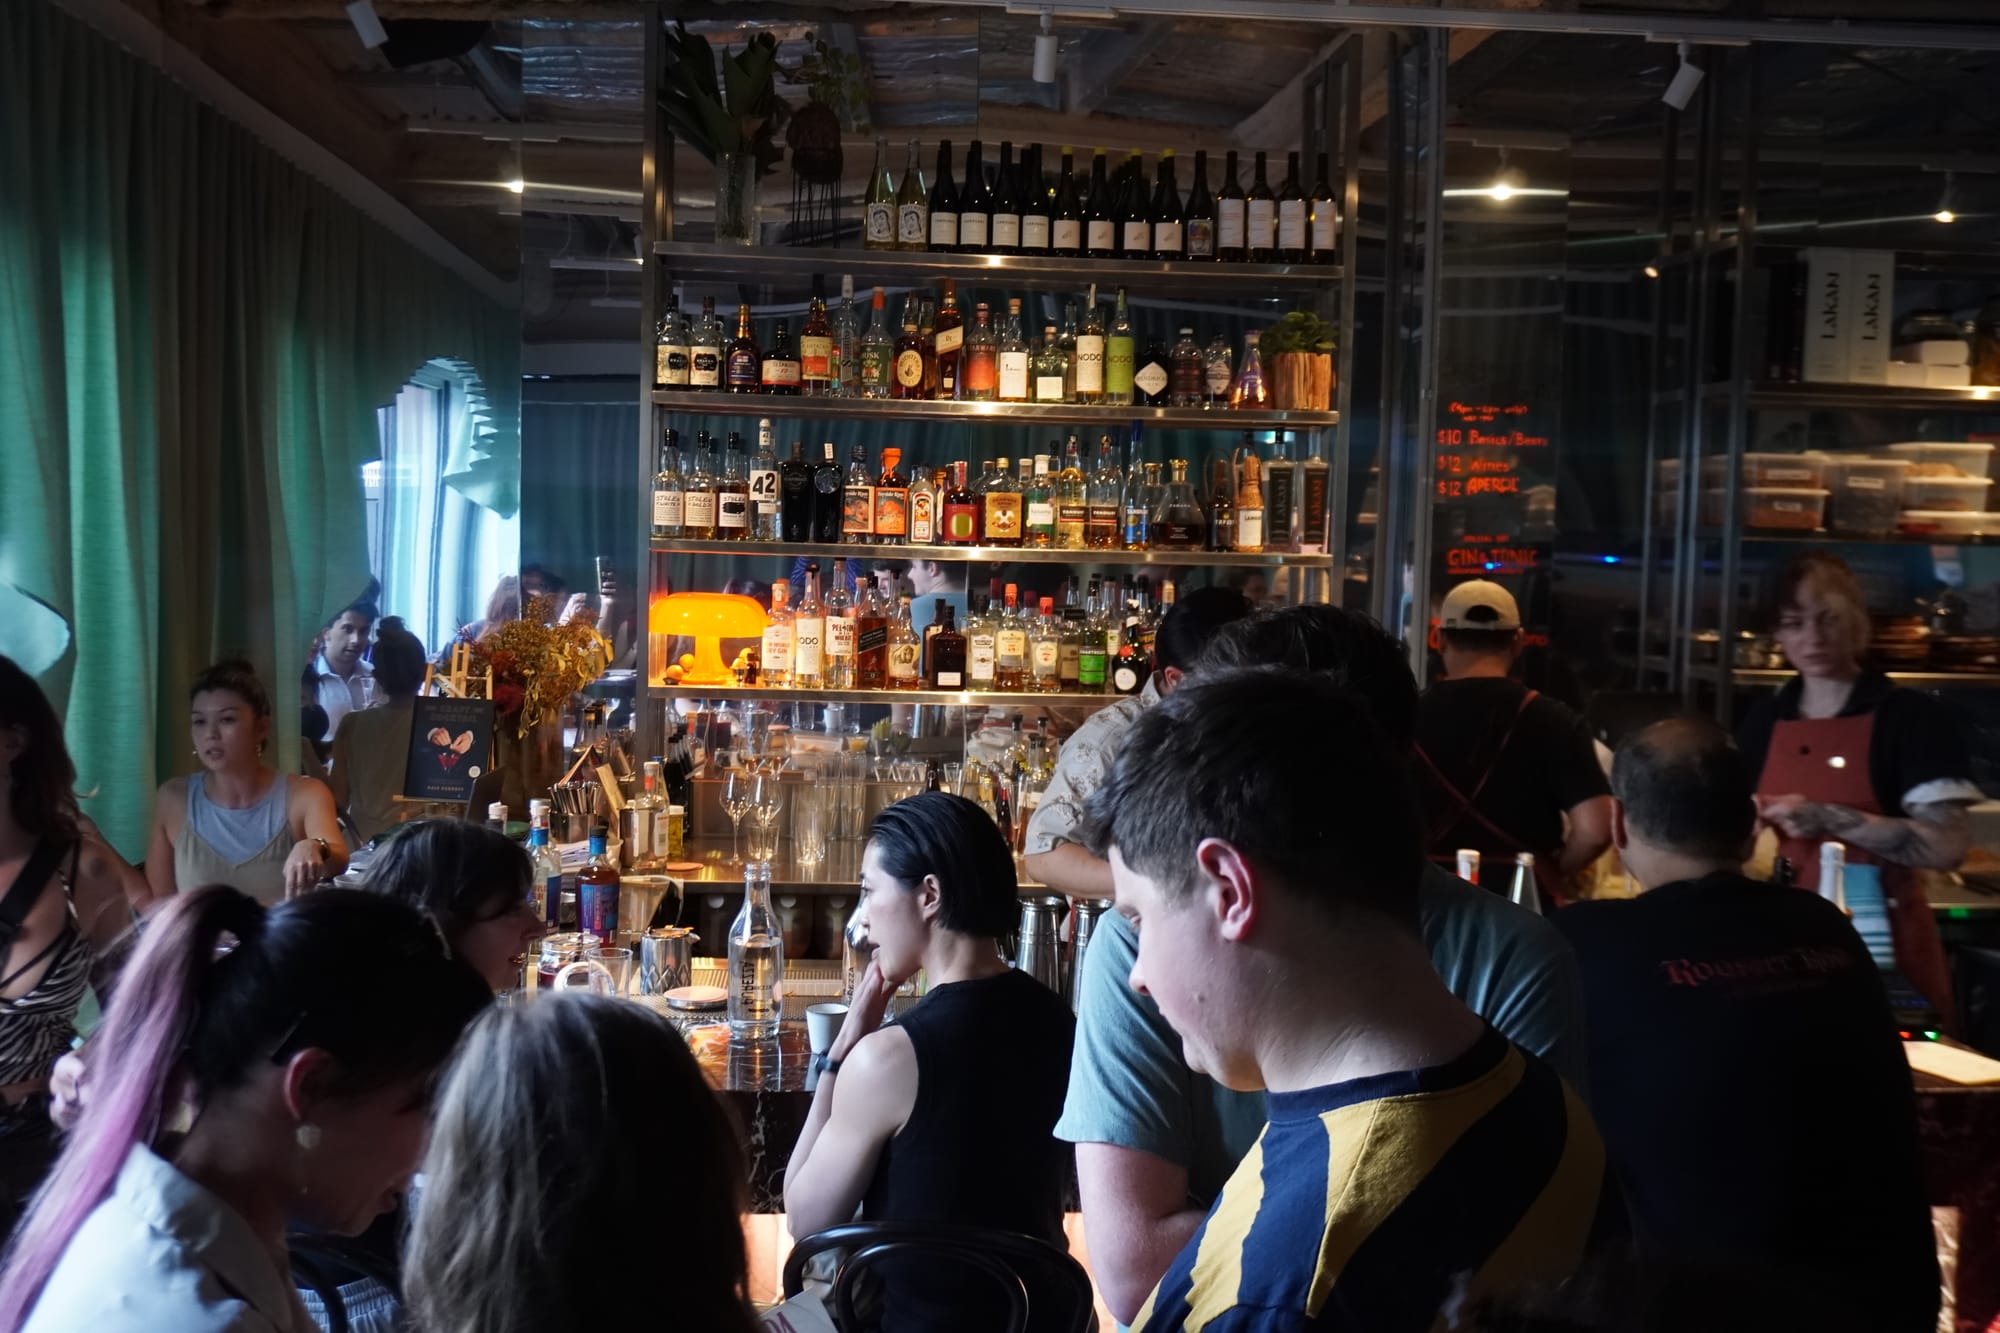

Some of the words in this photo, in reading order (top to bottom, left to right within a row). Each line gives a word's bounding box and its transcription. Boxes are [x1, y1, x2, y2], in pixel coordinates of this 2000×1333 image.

[1820, 272, 1840, 339] LAKAN
[1861, 273, 1881, 340] LAKAN
[1077, 353, 1102, 361] NODO
[752, 473, 775, 494] 42
[1438, 480, 1461, 496] $12
